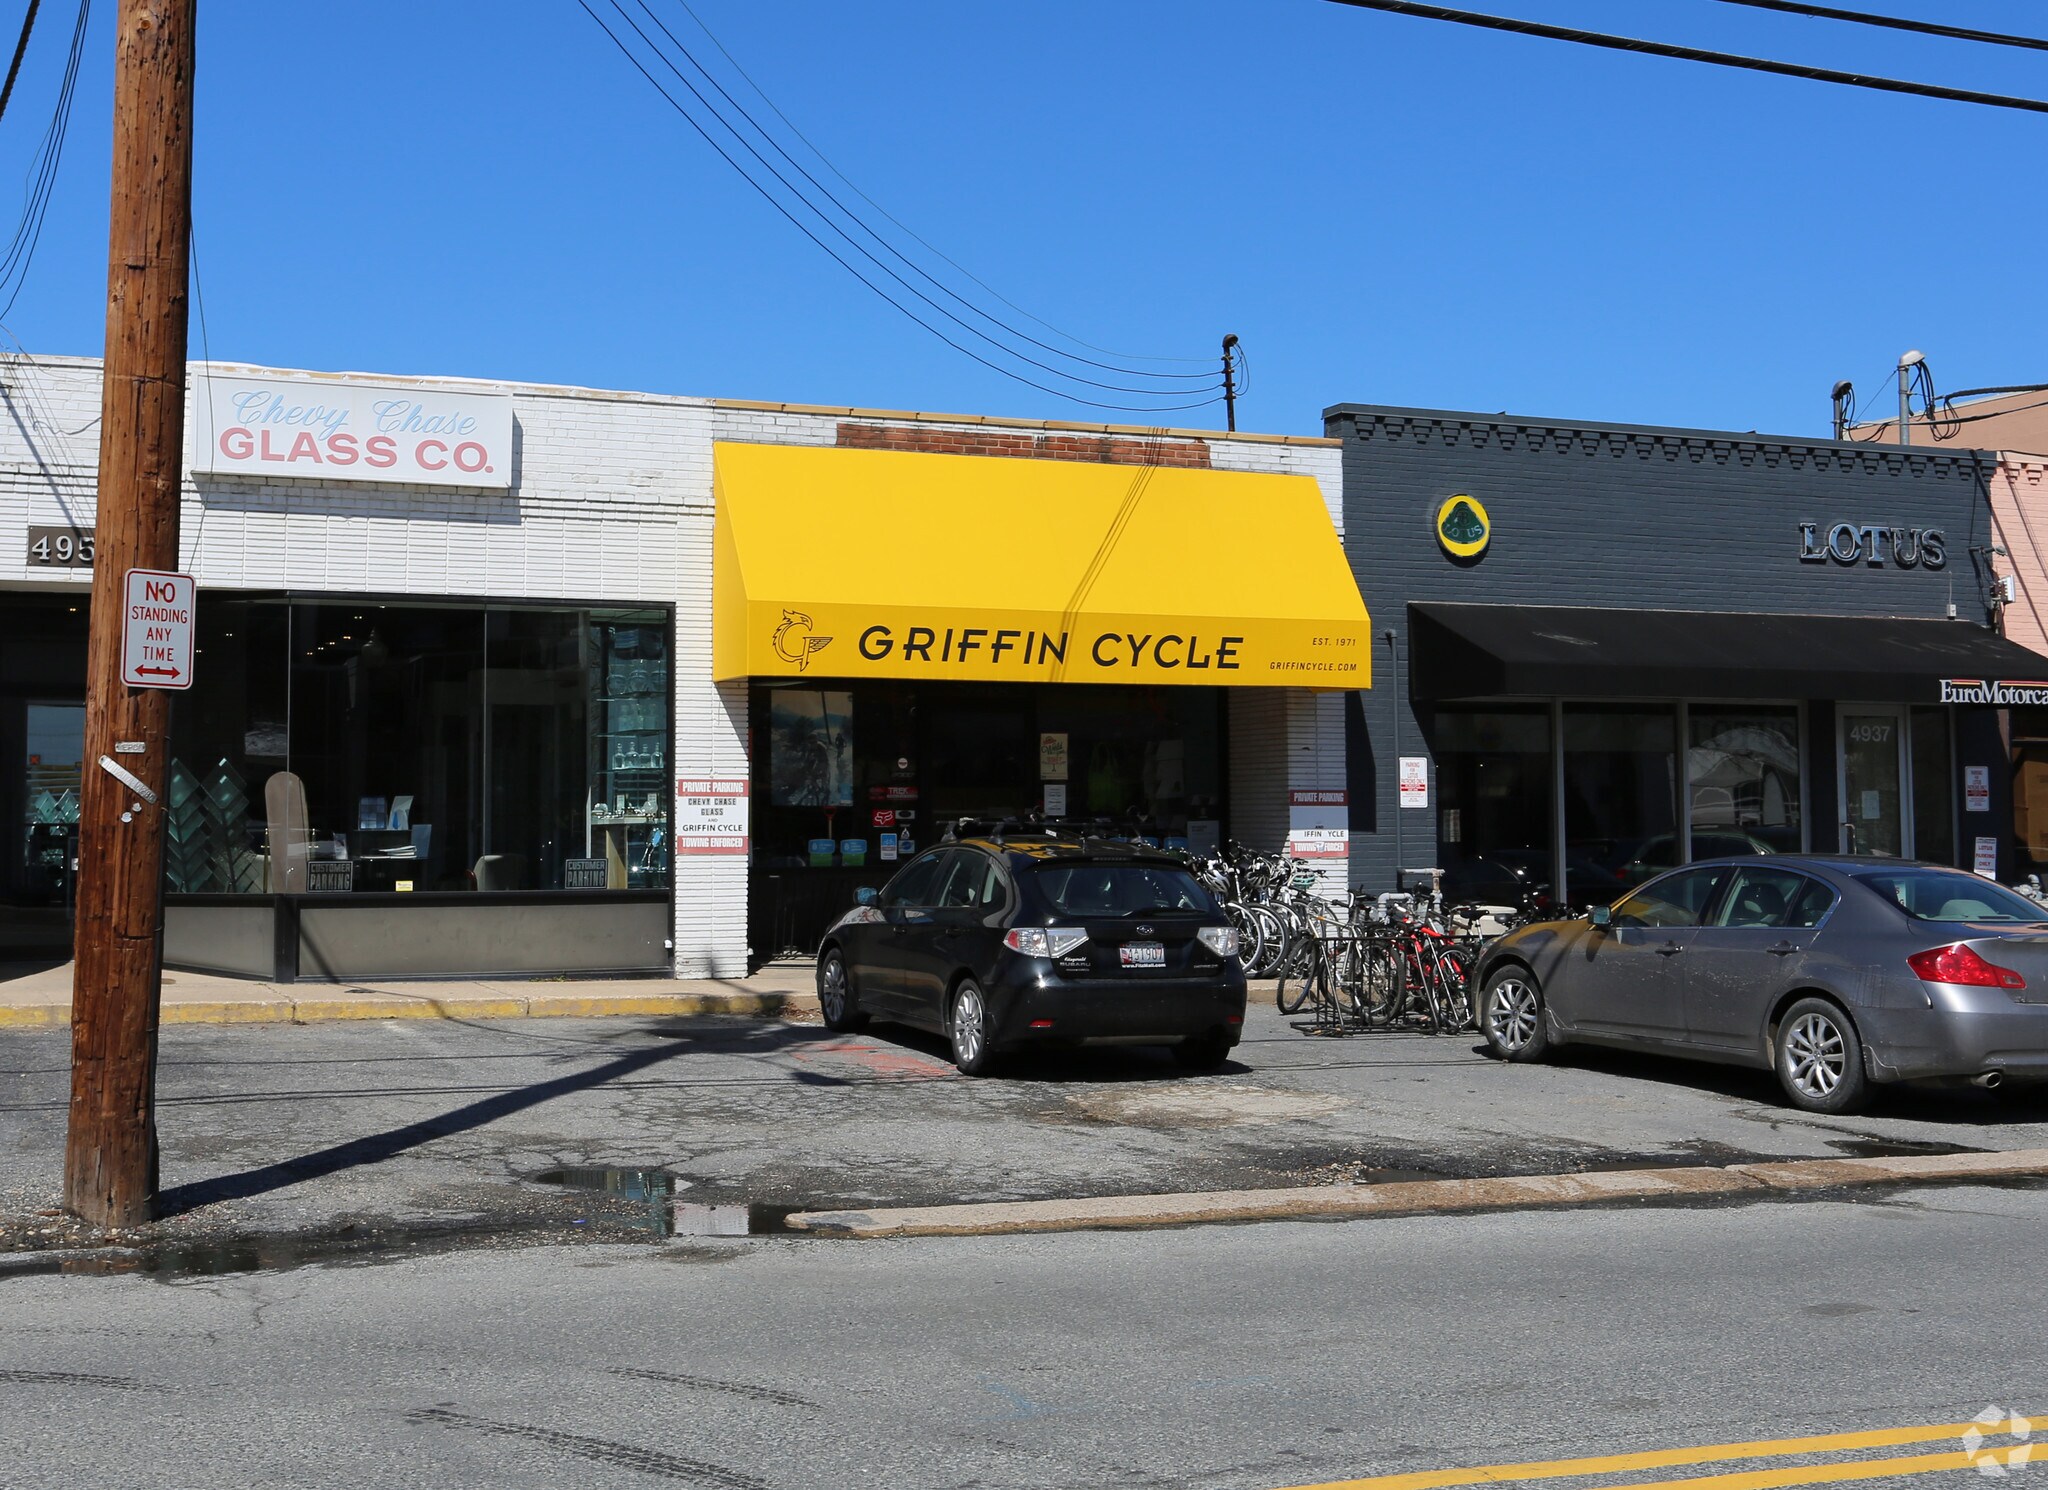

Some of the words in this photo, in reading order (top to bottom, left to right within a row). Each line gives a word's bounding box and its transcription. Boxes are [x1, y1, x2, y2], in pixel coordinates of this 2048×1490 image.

[232, 390, 350, 441] Chevy
[373, 400, 478, 437] Chase
[219, 427, 398, 468] GLASS
[414, 439, 494, 473] CO.
[1800, 522, 1946, 568] LOTUS
[145, 580, 176, 603] NO
[131, 605, 188, 624] STANDING
[146, 627, 172, 642] ANY
[858, 625, 1069, 665] GRIFFIN
[1092, 632, 1244, 669] CYCLE
[1312, 637, 1332, 646] EST.
[1336, 638, 1356, 647] 1971
[143, 646, 174, 662] TIME
[1269, 661, 1357, 672] GRIFFINCYCLE.COM
[1850, 725, 1890, 742] 4937
[682, 781, 711, 793] PRIVATE
[712, 781, 744, 793] PARKING
[888, 787, 908, 795] TREK
[688, 798, 711, 806] CHEVY
[714, 798, 737, 806] CHASE
[1294, 792, 1318, 802] PRIVATE
[1318, 792, 1344, 802] PARKING
[701, 808, 724, 816] GLASS
[682, 824, 716, 832] GRIFFIN
[717, 824, 743, 832] CYCLE
[682, 837, 710, 848] TOWING
[710, 837, 743, 848] ENFORCED
[1318, 842, 1344, 852] FORCED
[310, 863, 351, 873] CUSTOMER
[568, 861, 606, 870] CUSTOMER
[310, 873, 350, 891] PARKING
[567, 870, 605, 887] PARKING
